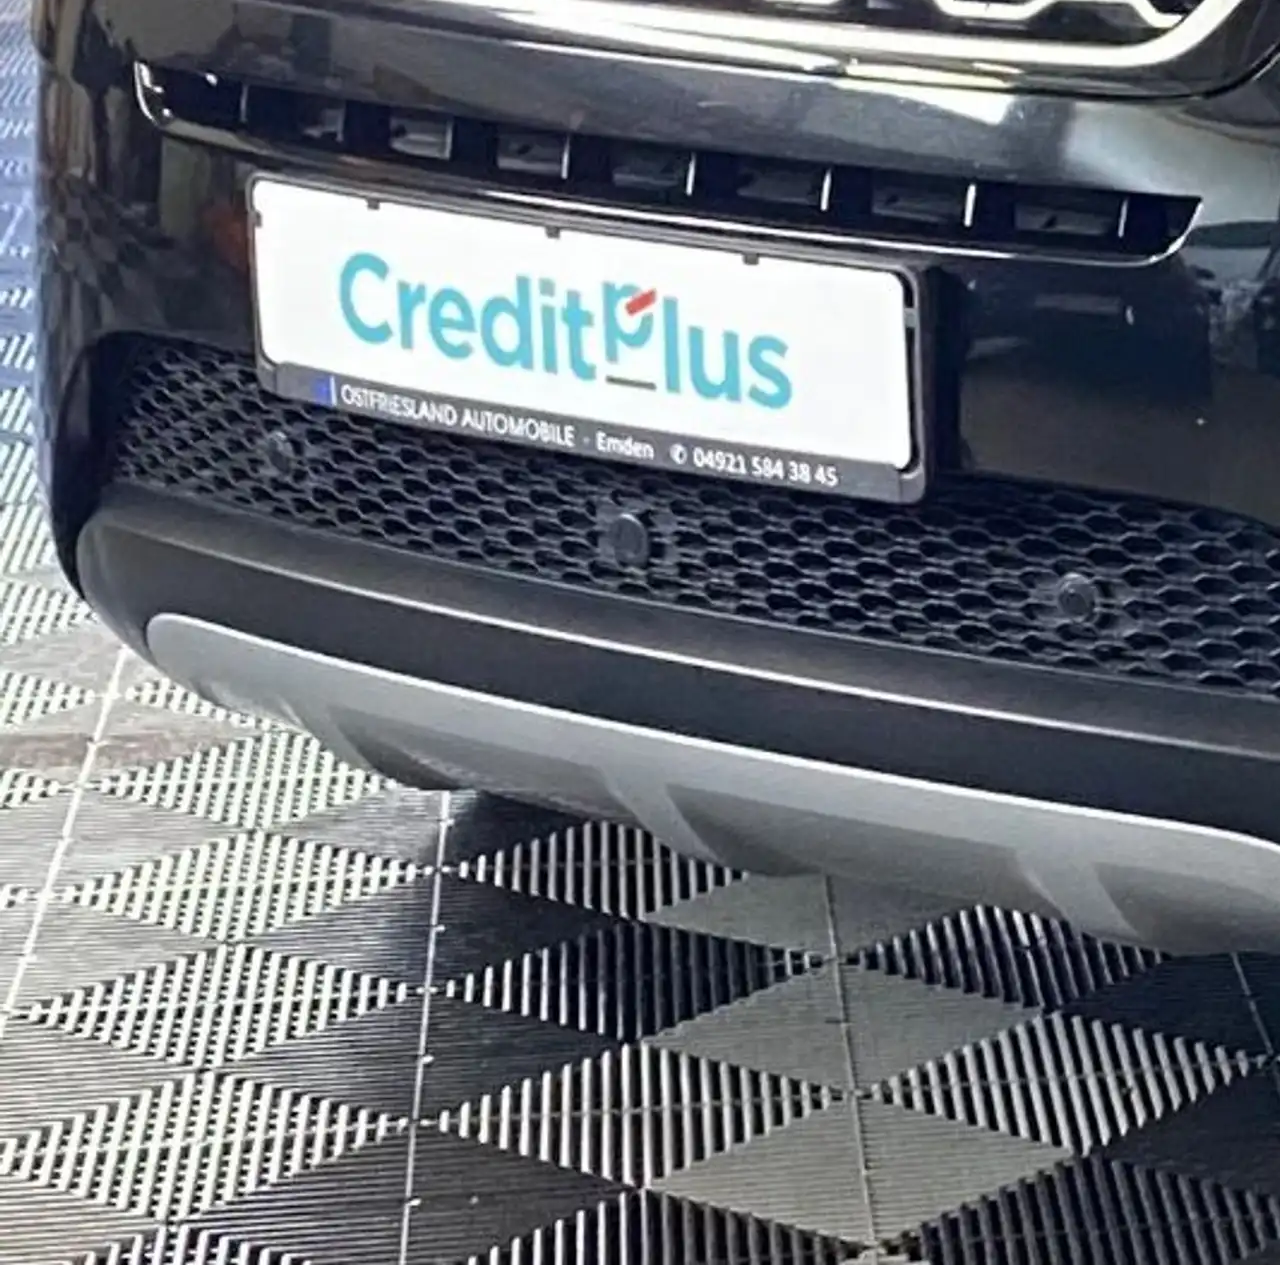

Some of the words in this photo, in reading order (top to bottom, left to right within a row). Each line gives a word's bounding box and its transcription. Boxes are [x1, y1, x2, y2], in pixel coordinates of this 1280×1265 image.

[339, 251, 793, 410] CreditPlus
[340, 384, 458, 427] OSTFRIESLAND
[461, 408, 576, 448] AUTOMOBILE
[596, 431, 655, 461] Emden
[693, 448, 747, 475] 04921
[751, 456, 784, 480] 584
[788, 461, 812, 484] 38
[814, 465, 838, 487] 45
